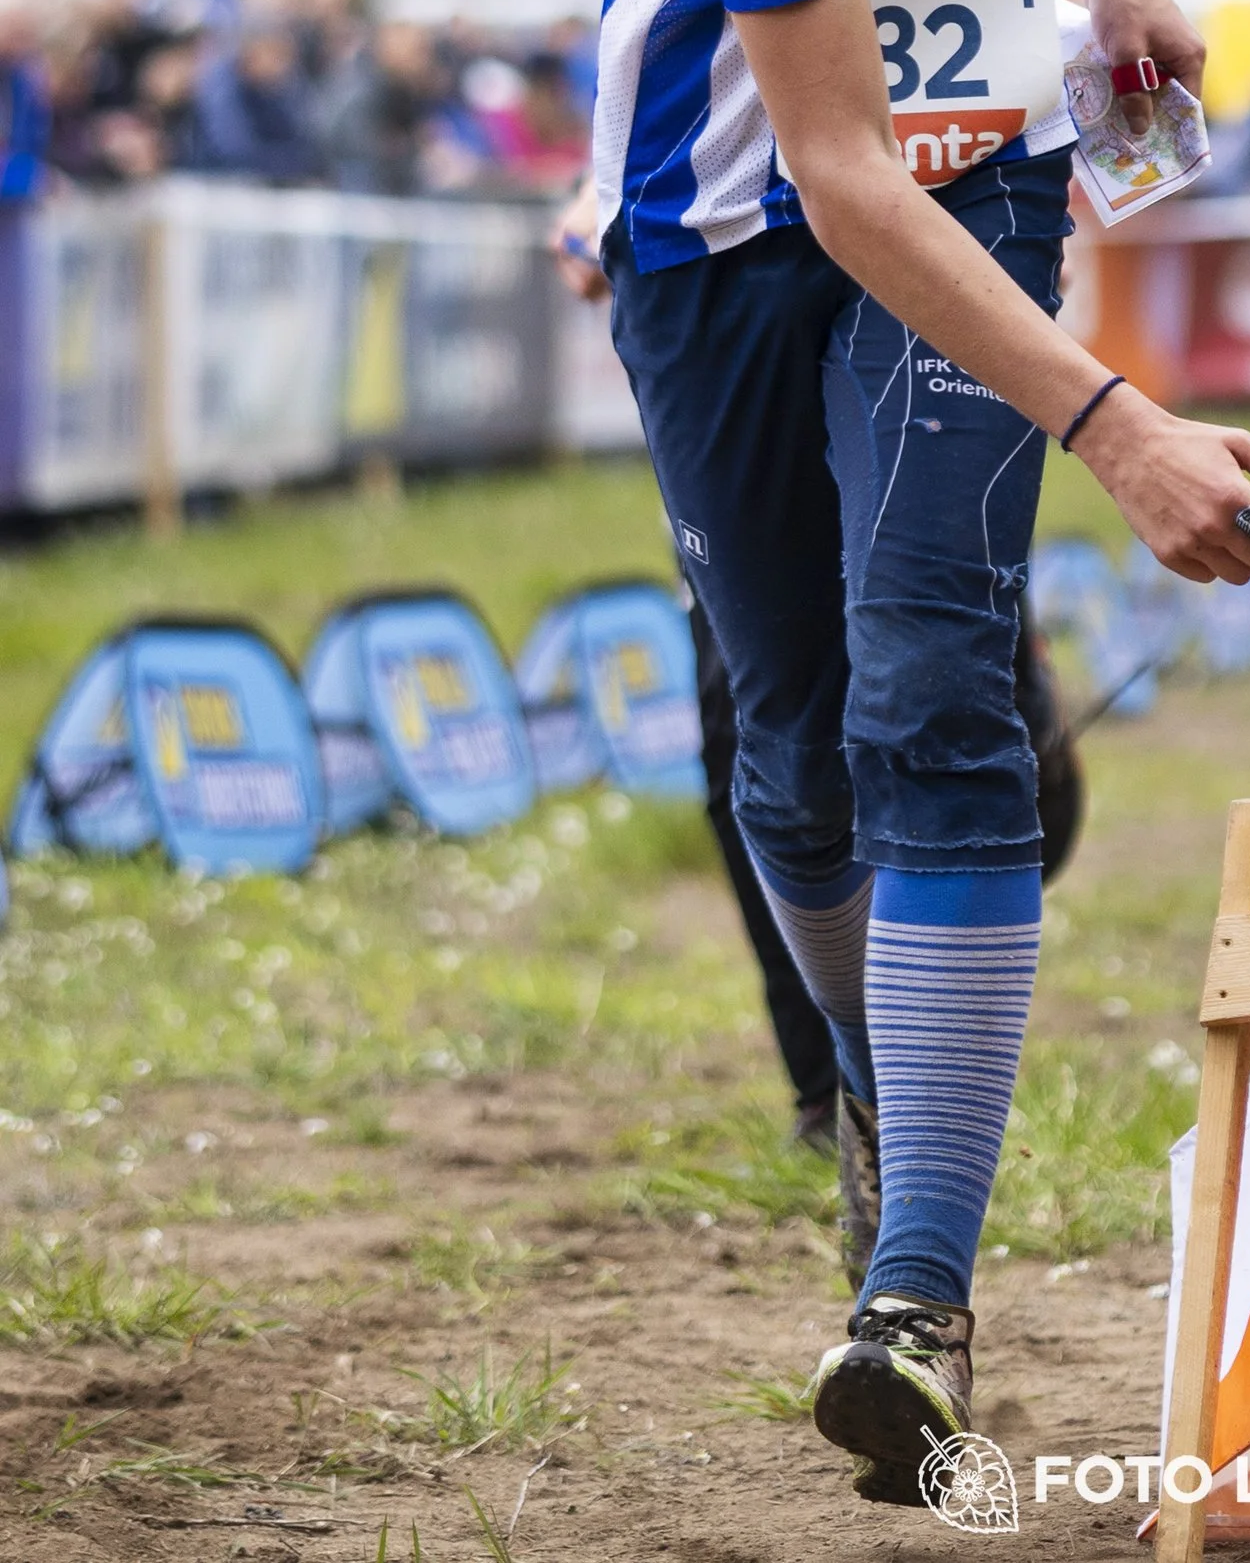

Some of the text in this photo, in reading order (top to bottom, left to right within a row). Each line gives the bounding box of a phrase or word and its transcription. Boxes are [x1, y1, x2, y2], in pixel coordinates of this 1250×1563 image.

[895, 123, 1004, 172] nta
[916, 358, 952, 373] IFK
[928, 377, 1009, 405] Orient
